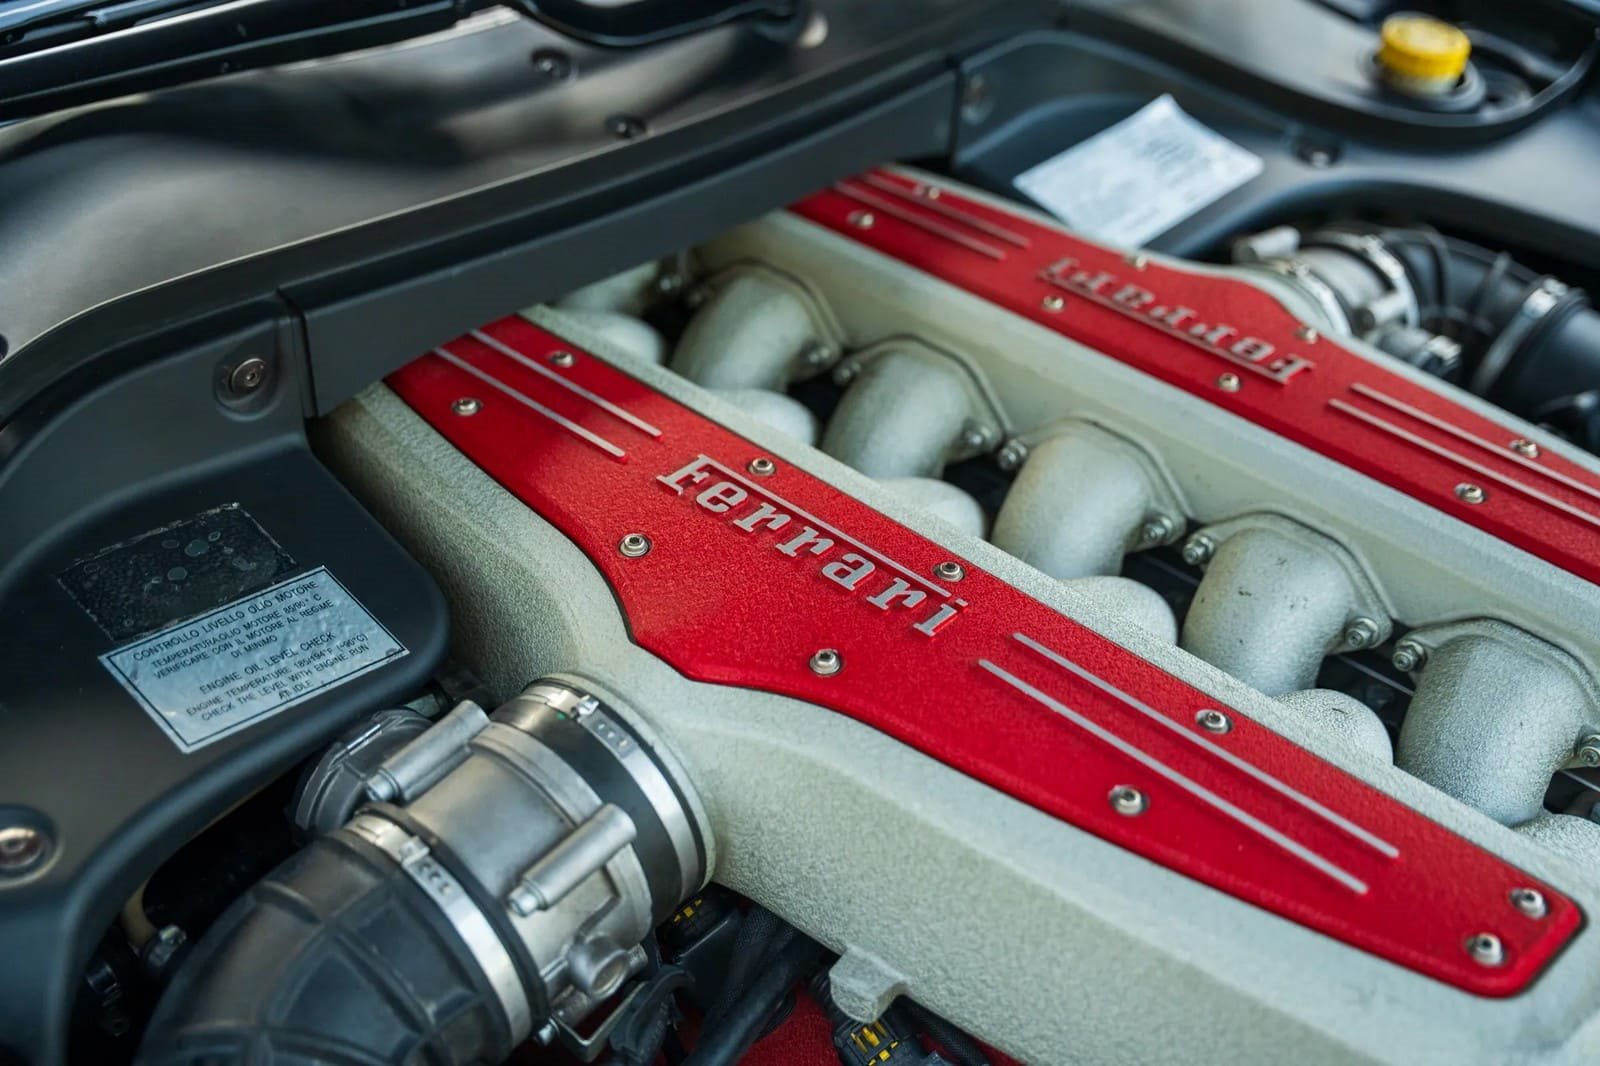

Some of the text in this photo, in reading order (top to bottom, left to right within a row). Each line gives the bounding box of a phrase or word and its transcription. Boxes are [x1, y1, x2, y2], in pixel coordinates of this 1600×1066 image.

[1037, 256, 1315, 386] Ferrari
[656, 453, 968, 637] Ferrari
[132, 581, 318, 661] CONTROLLO LIVELLO OLIO MOTORE
[153, 652, 208, 678] VERIFICARE
[211, 641, 232, 654] CON
[246, 620, 283, 640] MOTORE
[286, 615, 297, 623] AL
[300, 600, 333, 617] REGIME
[230, 634, 277, 657] DI MINIMO
[243, 611, 281, 630] MOTORE
[186, 695, 223, 715] ENGINE
[226, 666, 291, 697] TEMPERATURE
[200, 631, 335, 693] ENGINE OIL LEVEL CHECK
[201, 644, 368, 720] CHECK THE LEVEL WITH ENGINE RUN
[292, 679, 312, 692] IDLE
